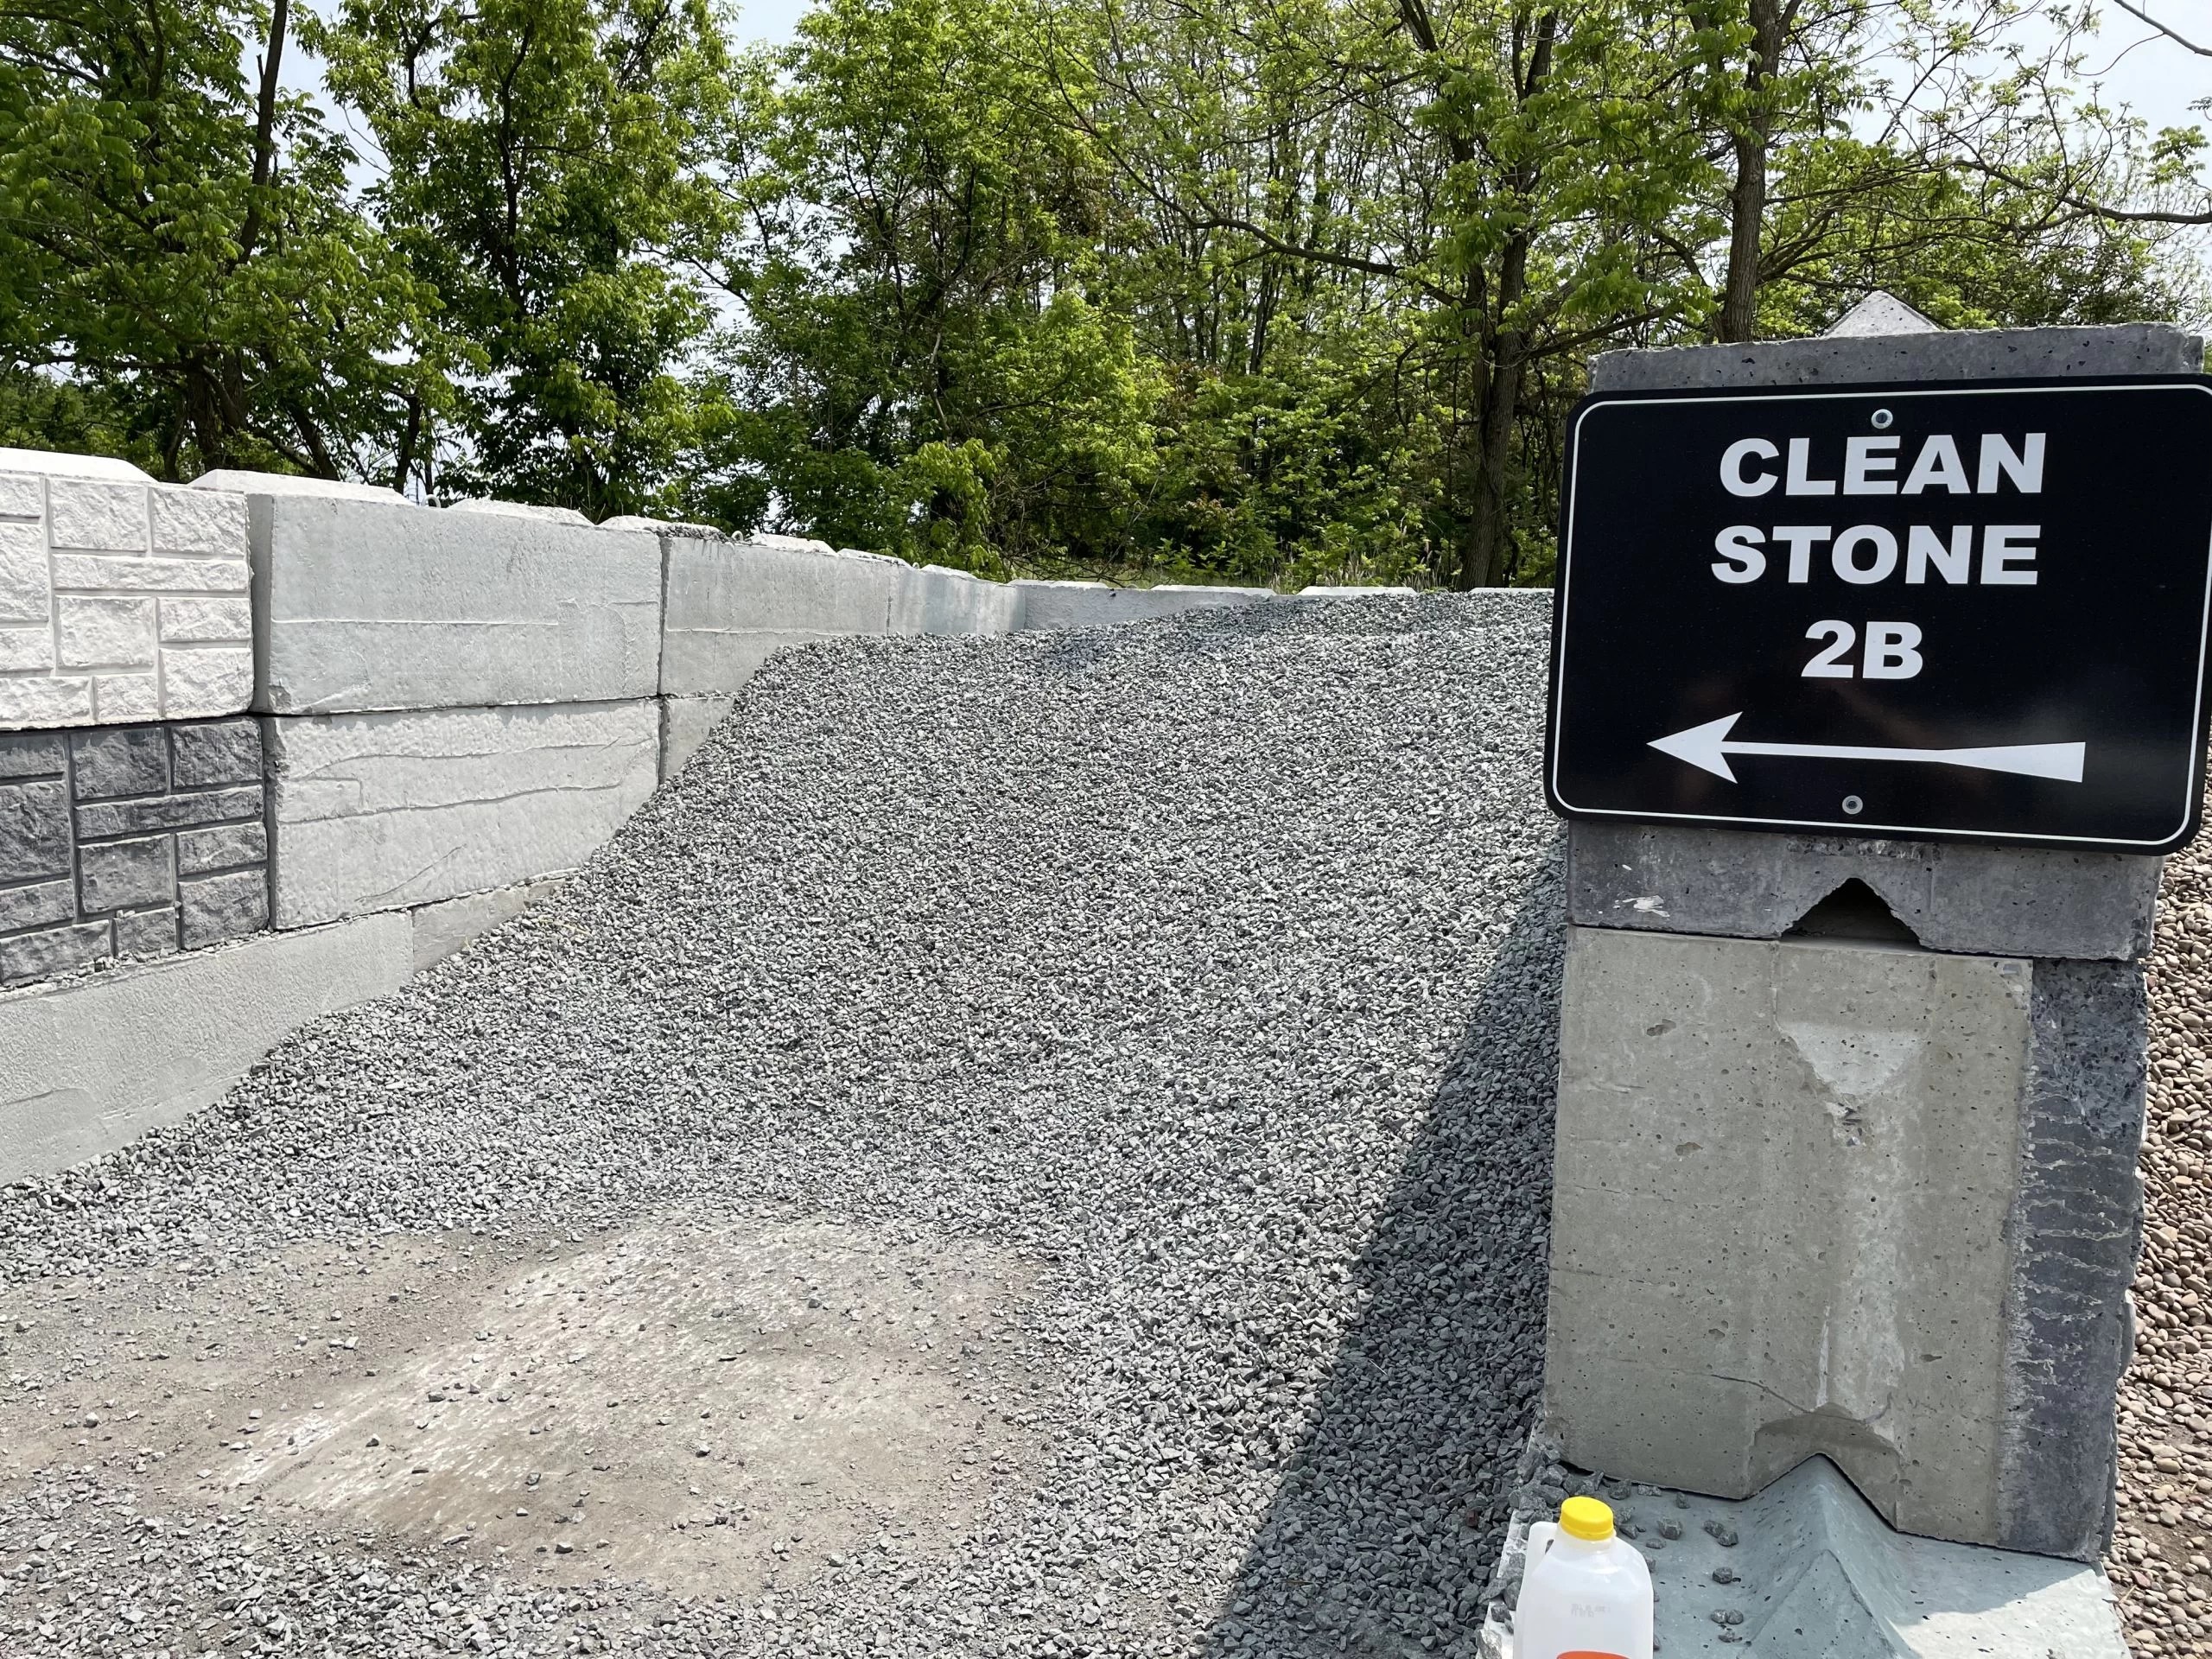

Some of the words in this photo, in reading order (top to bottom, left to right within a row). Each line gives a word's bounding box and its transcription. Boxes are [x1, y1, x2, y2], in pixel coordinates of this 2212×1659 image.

[1720, 433, 2045, 496] CLEAN
[1712, 525, 2040, 584] STONE
[1802, 620, 1923, 679] 2B
